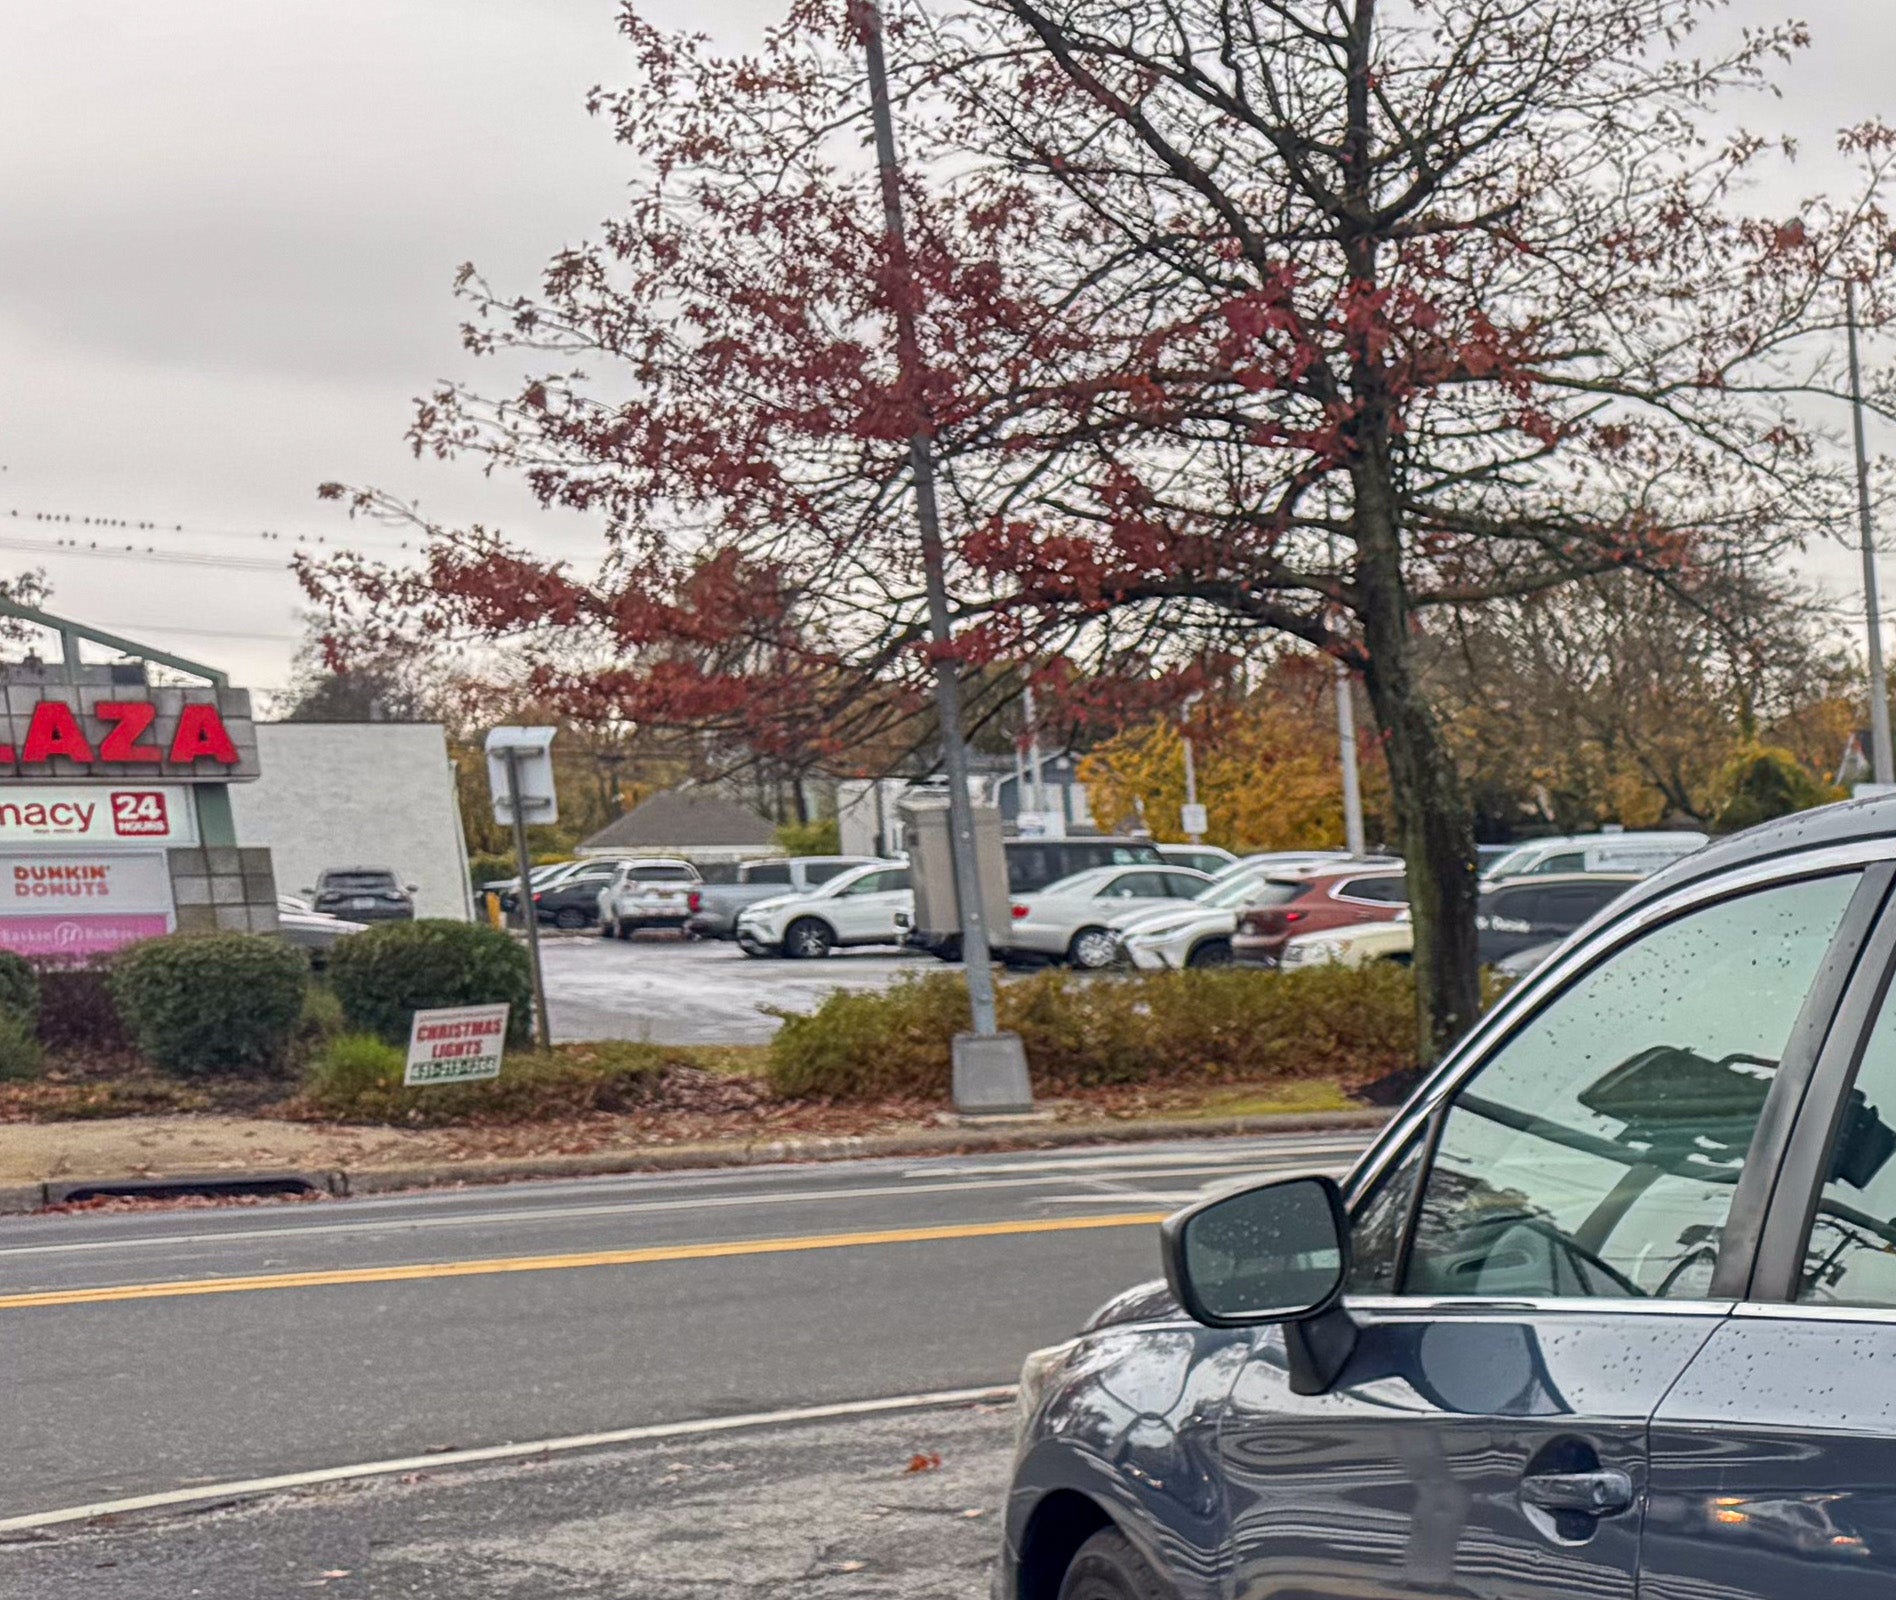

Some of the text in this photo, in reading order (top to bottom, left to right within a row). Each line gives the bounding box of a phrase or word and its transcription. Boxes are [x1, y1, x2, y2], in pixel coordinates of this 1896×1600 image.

[116, 796, 162, 820] 24
[14, 882, 110, 897] DONUTS
[416, 1018, 503, 1043] CHRISTMAS
[431, 1040, 482, 1059] LIGHTS
